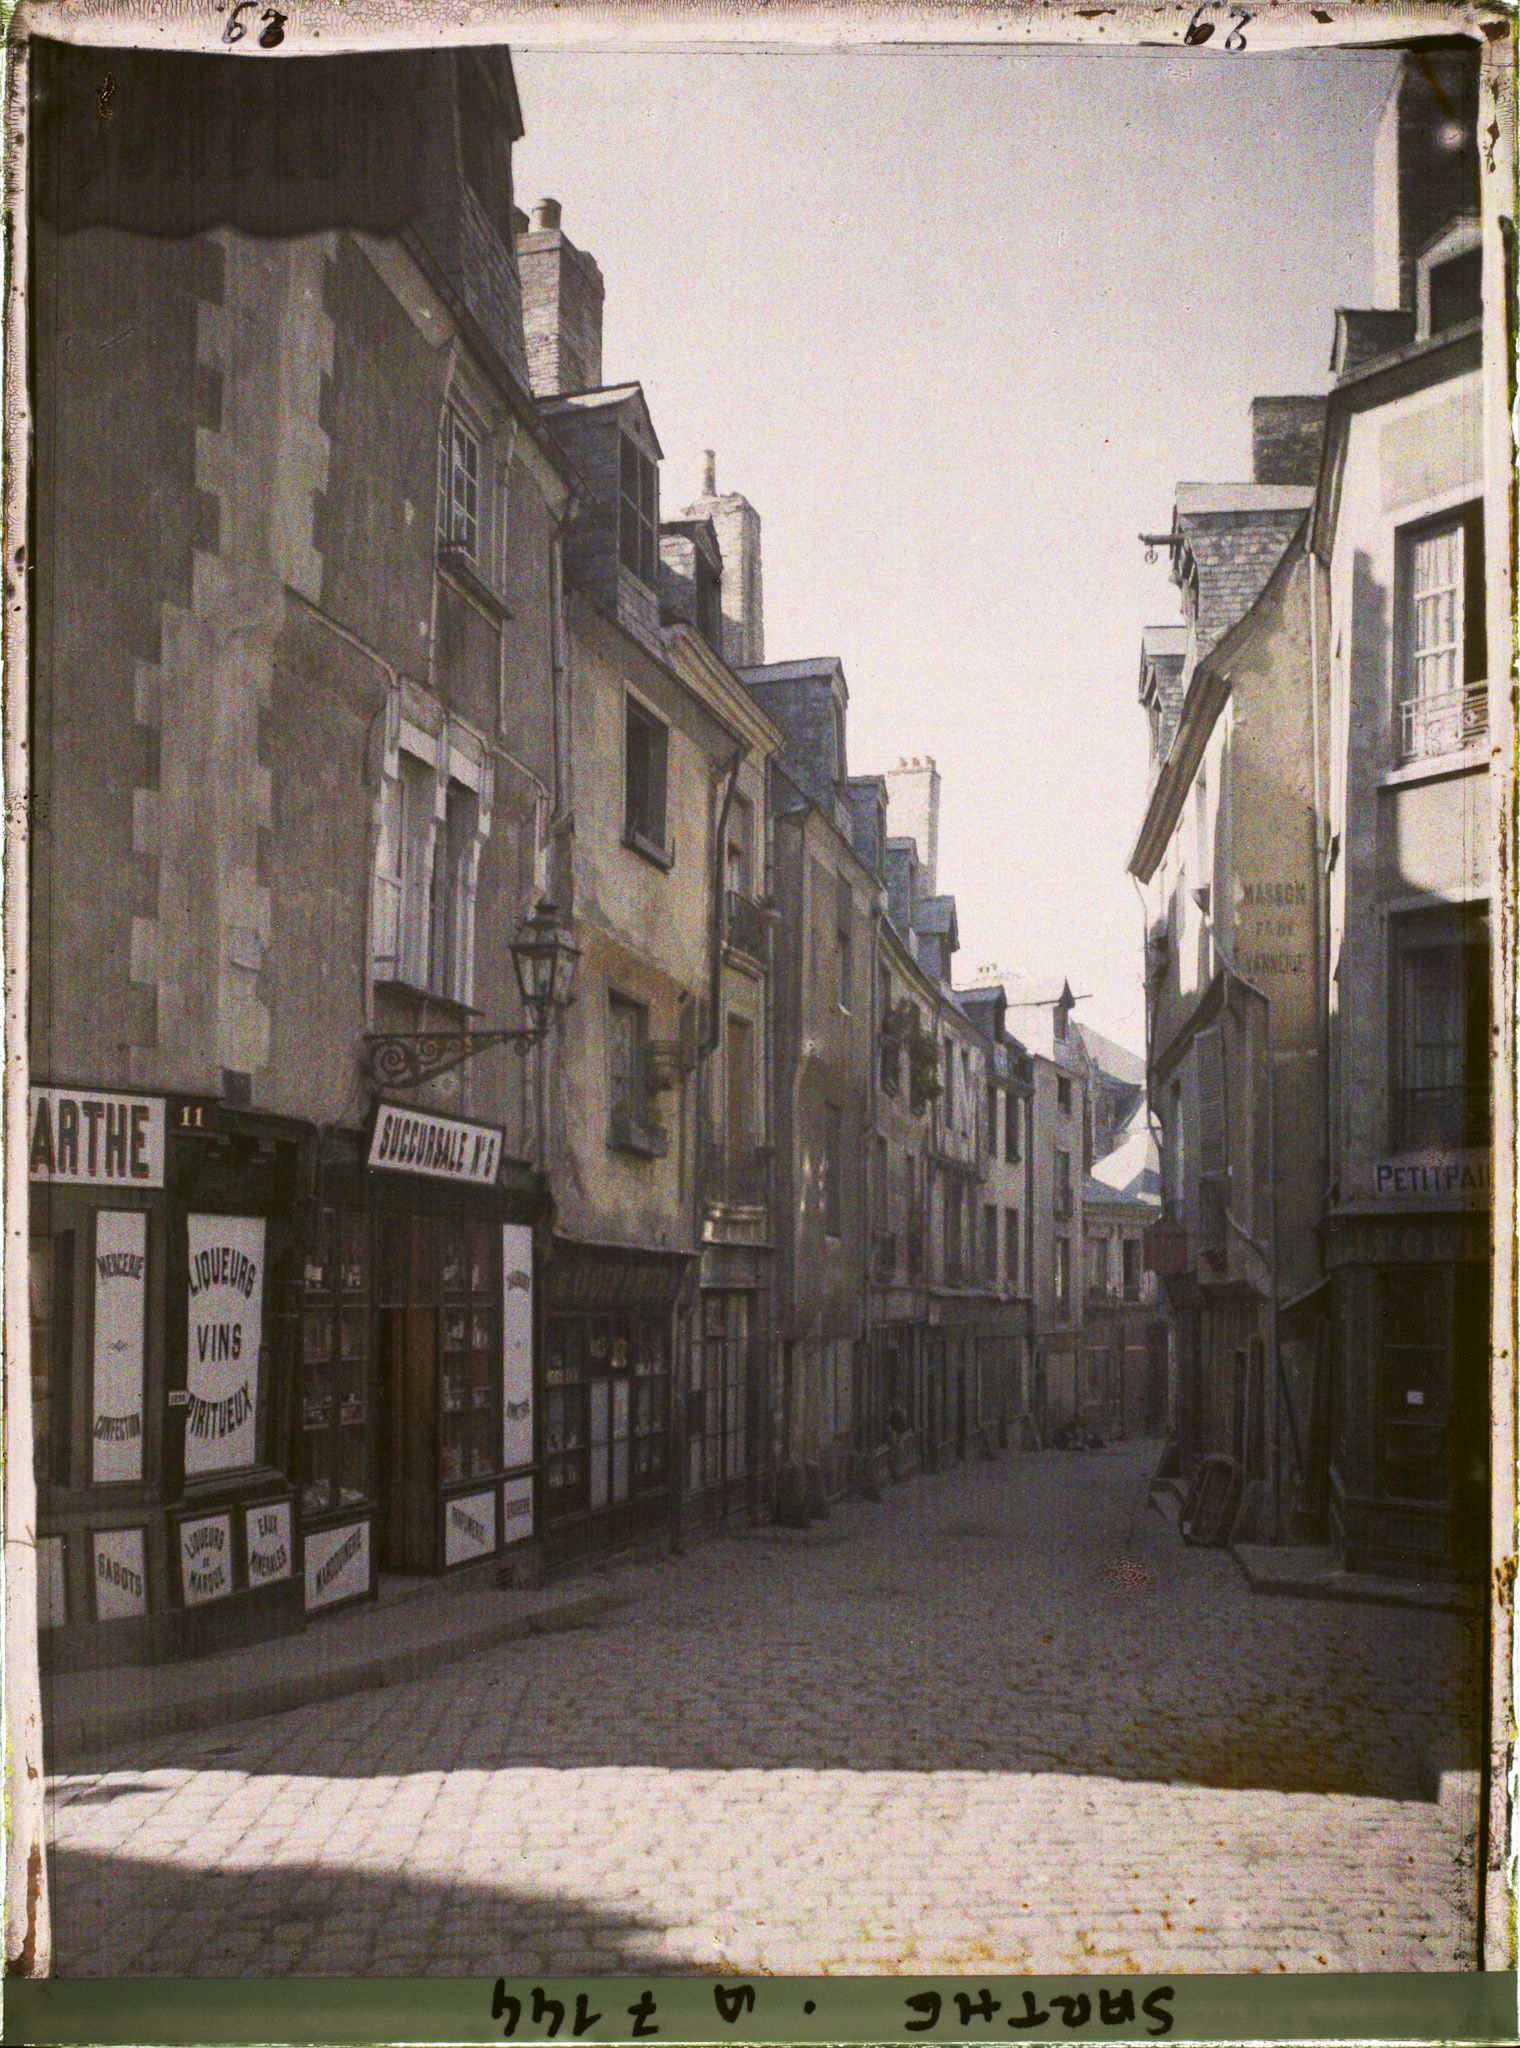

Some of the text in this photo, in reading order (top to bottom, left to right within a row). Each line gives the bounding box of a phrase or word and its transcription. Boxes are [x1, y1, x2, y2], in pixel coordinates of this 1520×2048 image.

[181, 1106, 204, 1127] 11
[30, 1097, 149, 1178] ARTHE
[378, 1114, 468, 1173] SUCCURSALE
[96, 1253, 144, 1281] MERCERIE
[188, 1247, 256, 1299] LIQUEURS
[198, 1323, 242, 1362] VINS
[93, 1412, 142, 1441] CONFECTION
[186, 1381, 252, 1439] PIRITUEUX
[184, 1526, 225, 1559] LIQUEURS
[257, 1515, 278, 1538] EAUX
[97, 1543, 142, 1597] SABOTS
[188, 1566, 225, 1595] MARQUE
[904, 1986, 1176, 2036] SARTHE
